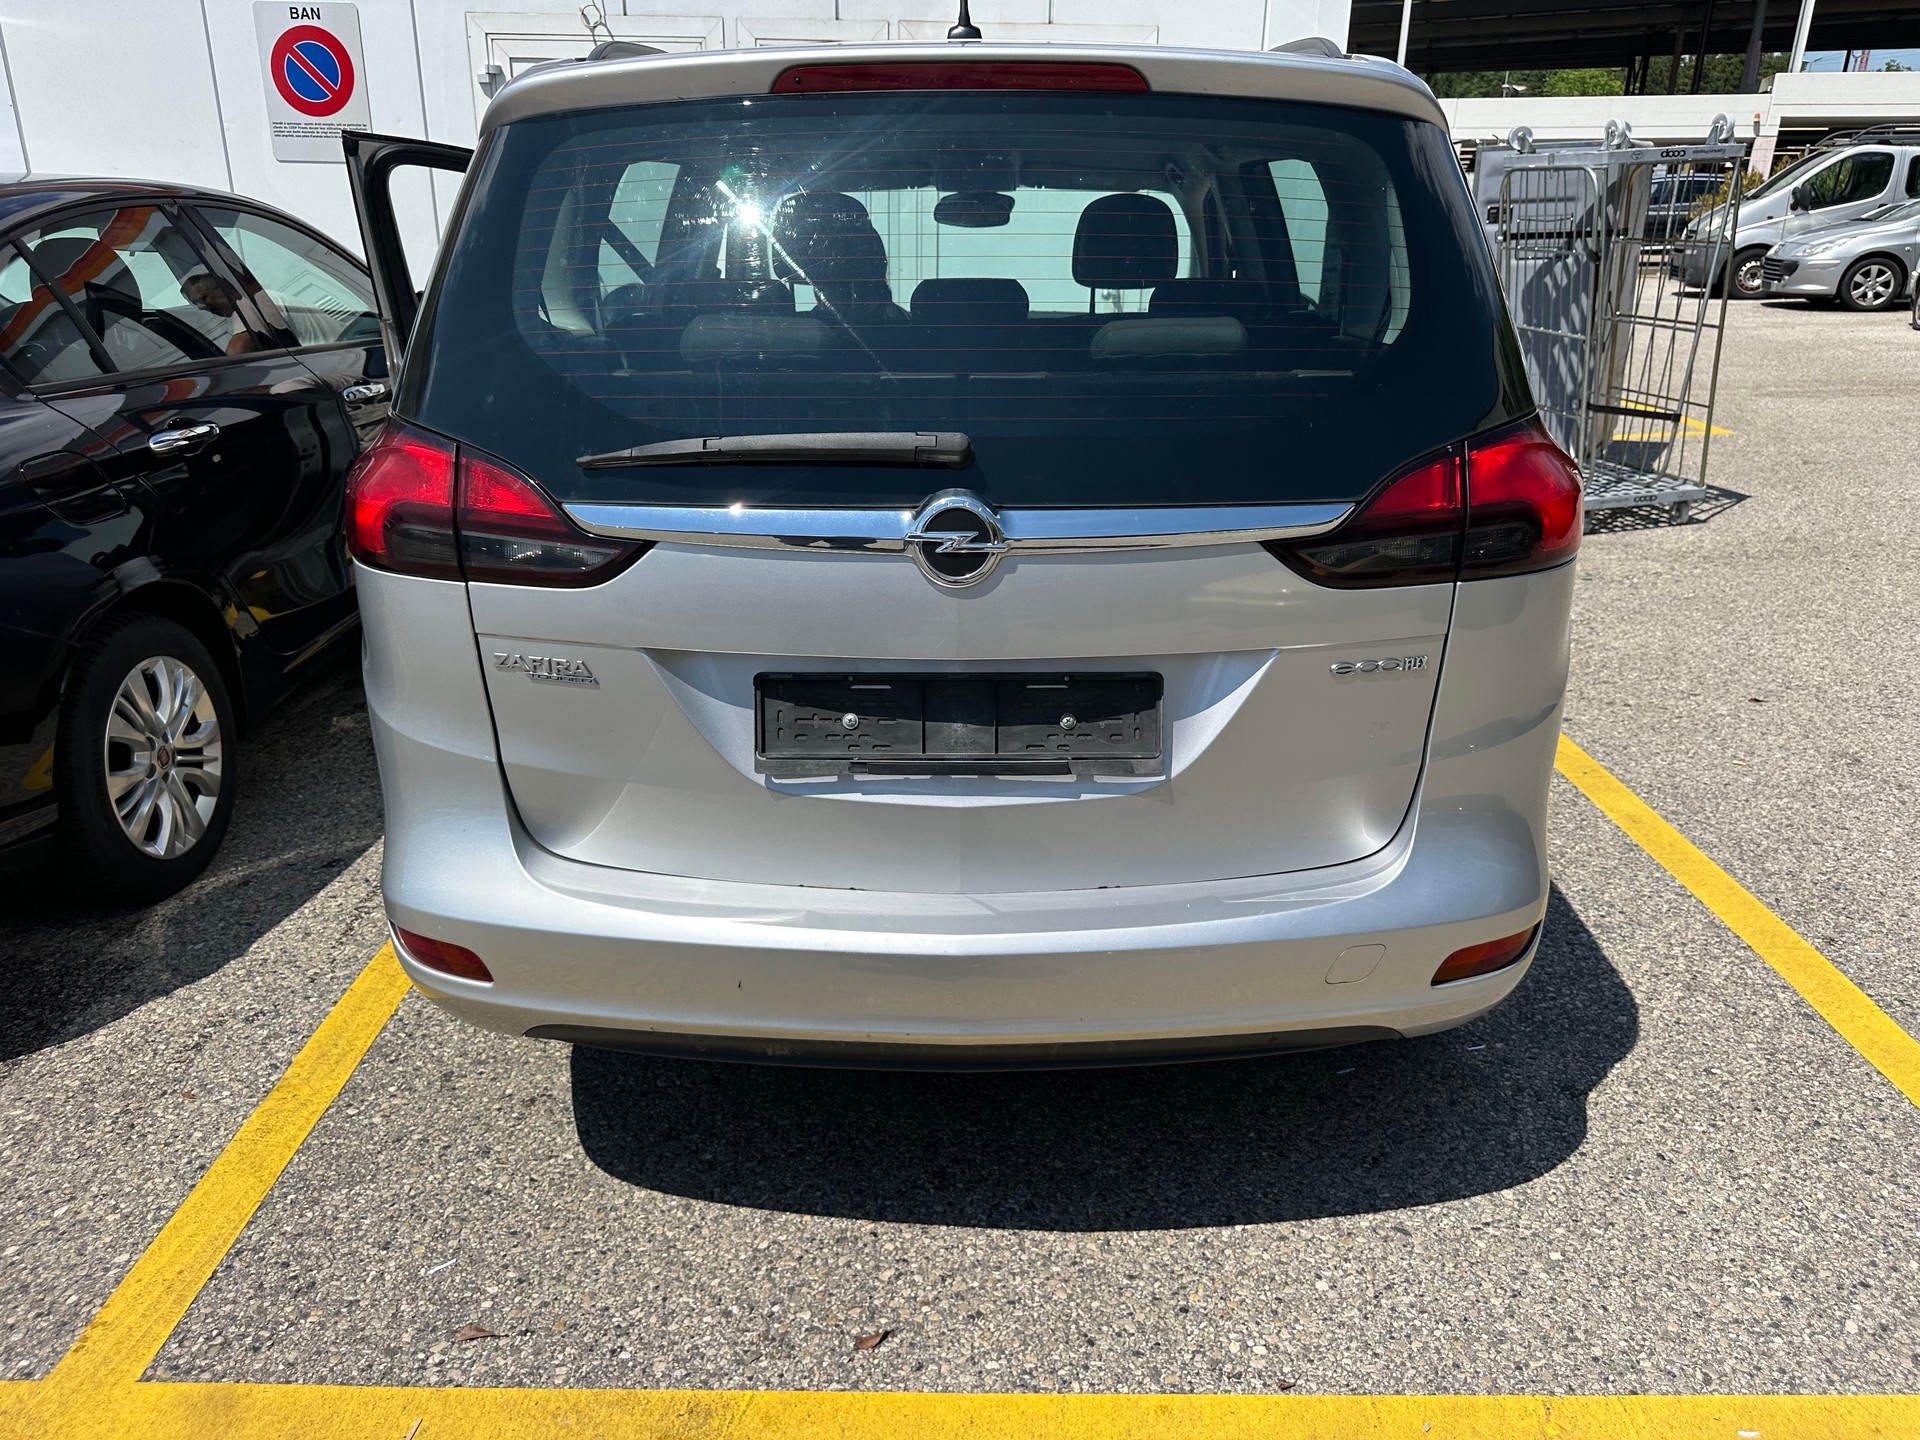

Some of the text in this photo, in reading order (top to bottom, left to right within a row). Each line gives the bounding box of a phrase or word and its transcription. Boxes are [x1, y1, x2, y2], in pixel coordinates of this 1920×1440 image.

[289, 6, 321, 20] BAN
[1660, 148, 1686, 158] coop
[1633, 494, 1658, 503] coop
[493, 652, 593, 677] ZAFIRA
